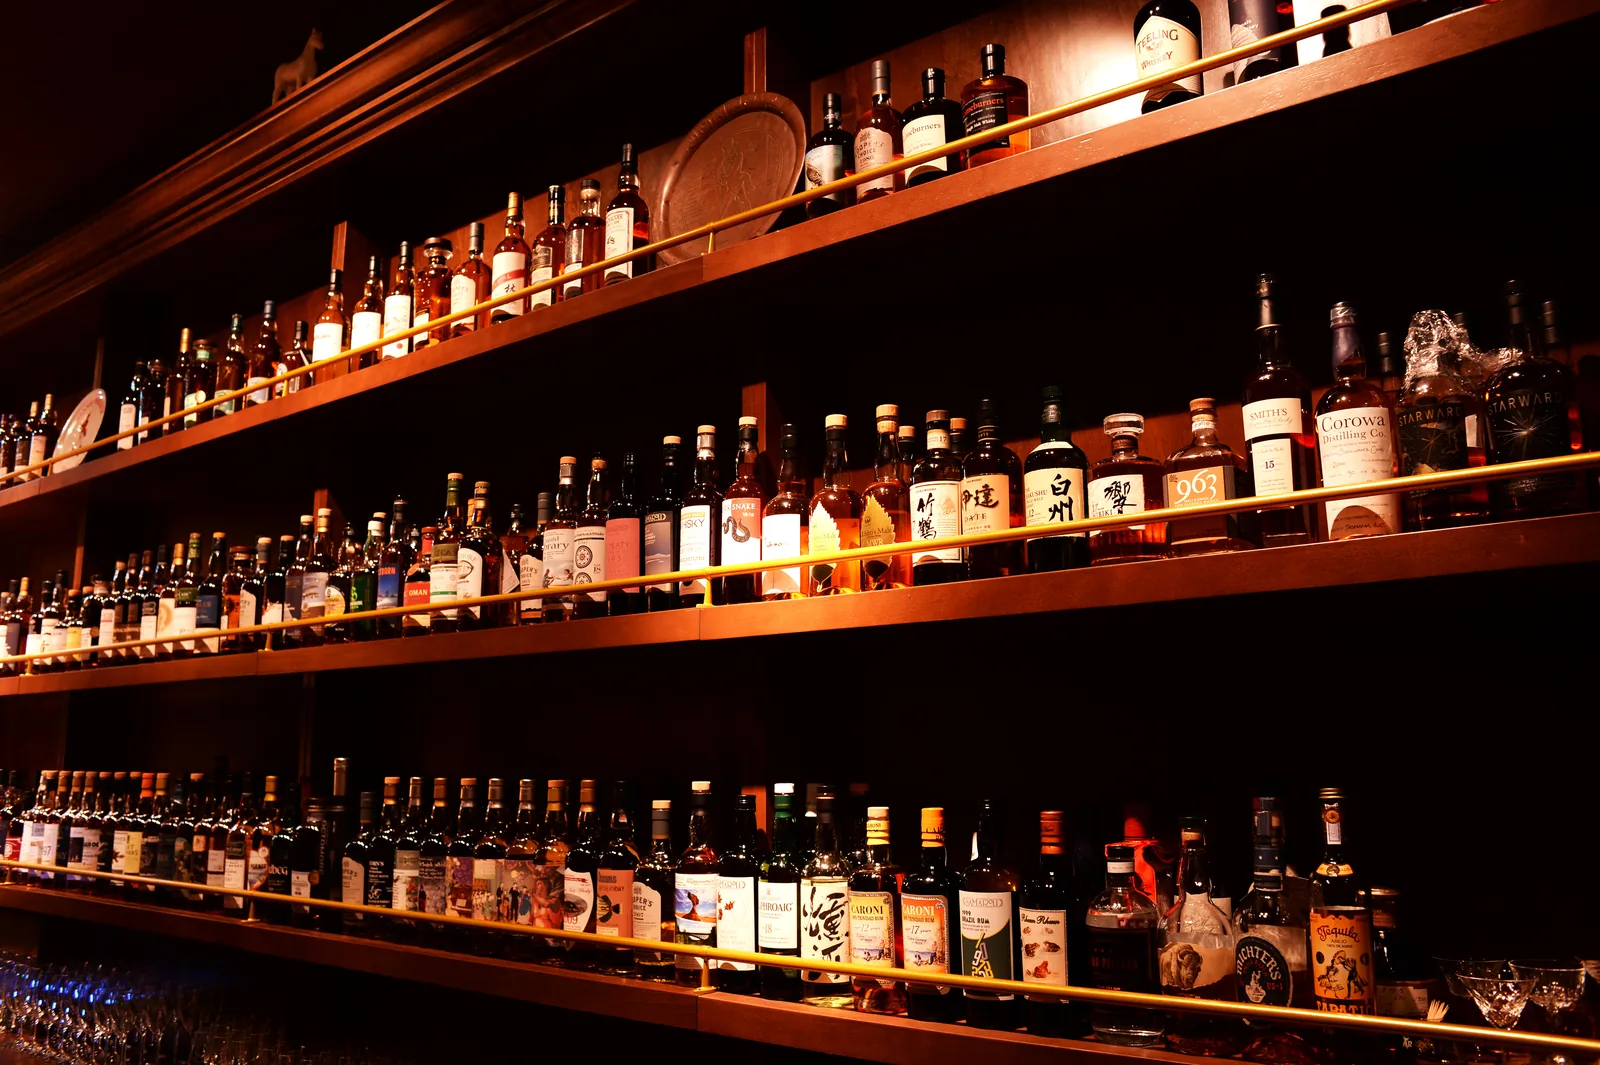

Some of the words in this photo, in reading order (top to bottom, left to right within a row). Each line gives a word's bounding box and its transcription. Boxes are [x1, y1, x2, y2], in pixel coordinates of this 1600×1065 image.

[1137, 29, 1179, 54] TEELING
[1487, 391, 1564, 416] STARWARD
[1249, 407, 1288, 420] SMITH'S
[1397, 405, 1463, 427] STARWARD
[1321, 414, 1386, 433] Corowa
[1322, 430, 1367, 444] Distilling
[1370, 429, 1387, 438] Co.
[1264, 460, 1275, 470] 15
[1173, 469, 1217, 505] 963
[731, 502, 756, 511] SNAKE
[961, 483, 999, 513] 伊達
[1049, 473, 1073, 522] 白州
[1104, 480, 1137, 515] 響
[916, 492, 937, 540] 竹鶴
[851, 904, 884, 915] CARONI
[903, 903, 935, 916] CARONI
[764, 923, 773, 934] 18
[911, 925, 920, 934] 17
[1316, 924, 1361, 943] Tequila
[1237, 945, 1282, 981] MICHTER'S
